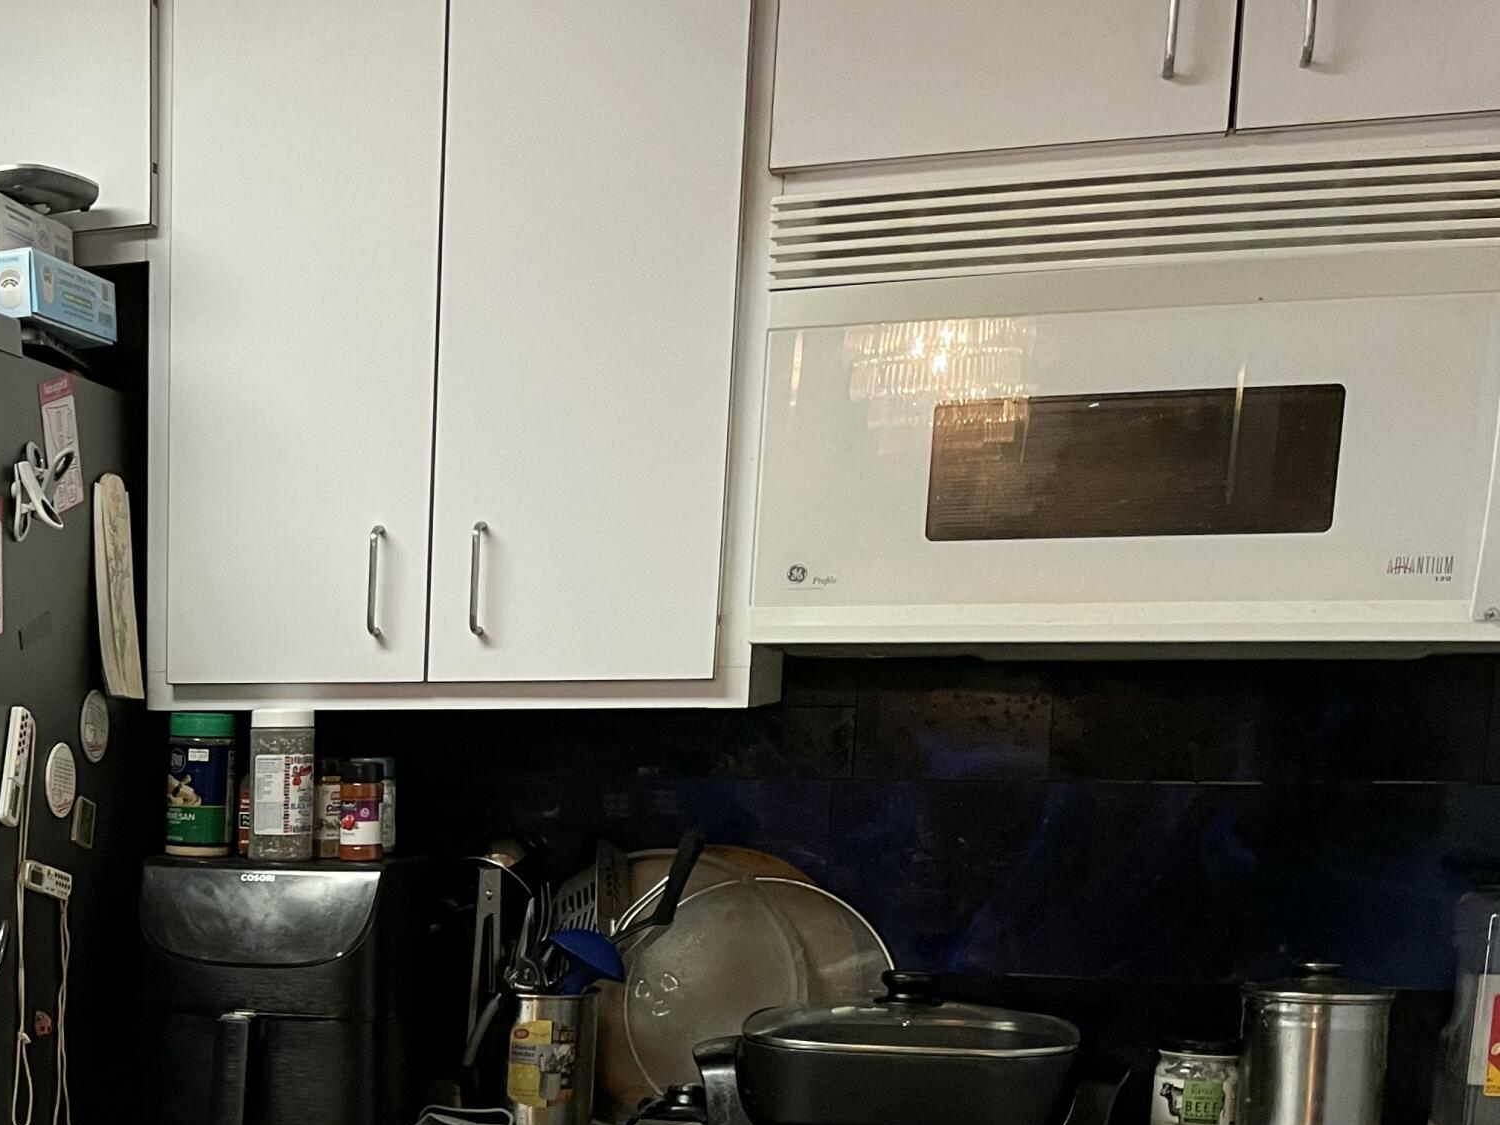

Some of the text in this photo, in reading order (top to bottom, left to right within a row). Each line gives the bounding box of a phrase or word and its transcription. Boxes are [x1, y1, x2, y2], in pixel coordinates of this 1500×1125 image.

[1386, 556, 1454, 574] ADVANTIUM
[241, 873, 276, 882] COSORI
[1185, 1100, 1220, 1113] BEEF
